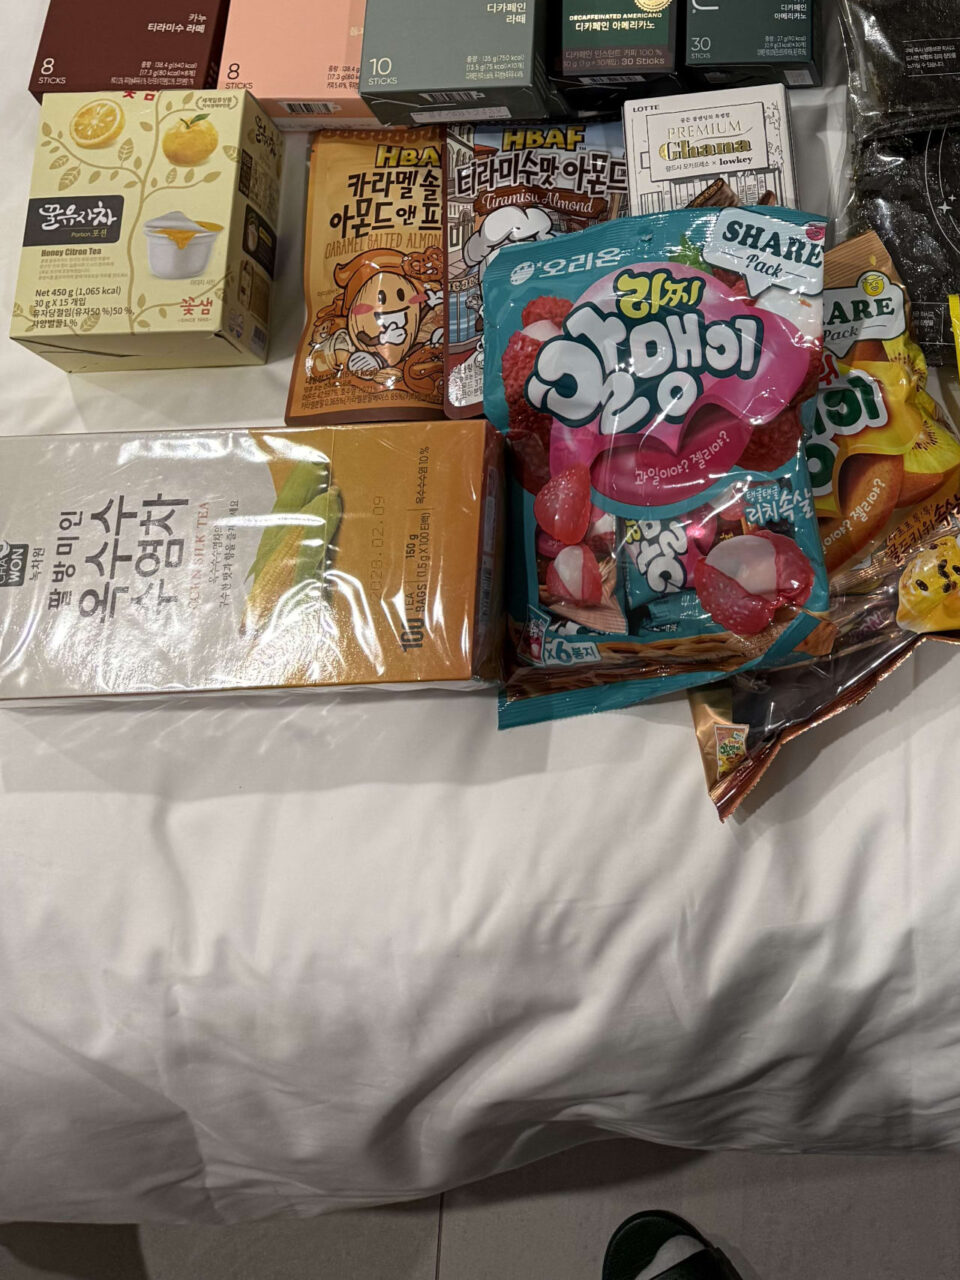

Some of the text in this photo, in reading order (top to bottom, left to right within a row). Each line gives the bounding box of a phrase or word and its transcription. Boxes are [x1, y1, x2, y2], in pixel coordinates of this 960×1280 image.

[487, 2, 527, 14] 디카페인
[506, 13, 526, 24] 라떼
[569, 11, 662, 21] DECAFFEINATED AMERICANO
[147, 22, 185, 33] 티라미수
[575, 20, 656, 31] 디카페인 아메리카노
[691, 37, 711, 51] 30
[41, 58, 55, 75] 8
[369, 57, 392, 75] 10
[636, 57, 665, 65] Sticks
[227, 63, 240, 80] 8
[38, 76, 66, 84] STICKS
[368, 76, 398, 85] STICKS
[667, 120, 742, 139] PREMIUM
[502, 126, 586, 151] HBAF
[659, 139, 752, 161] Ghana
[719, 156, 753, 166] lowkey
[481, 191, 595, 214] Tiramisu Almond
[722, 220, 824, 268] SHARE
[41, 247, 102, 257] Honey Citron Tea
[542, 248, 621, 277] 오리온
[745, 254, 783, 279] Pack
[35, 288, 50, 297] Net
[51, 288, 67, 297] 450
[102, 286, 121, 296] kcal)
[34, 299, 45, 307] 30
[60, 298, 70, 306] 15
[406, 542, 415, 560] 150
[8, 548, 23, 583] WON
[415, 584, 427, 613] BAGS
